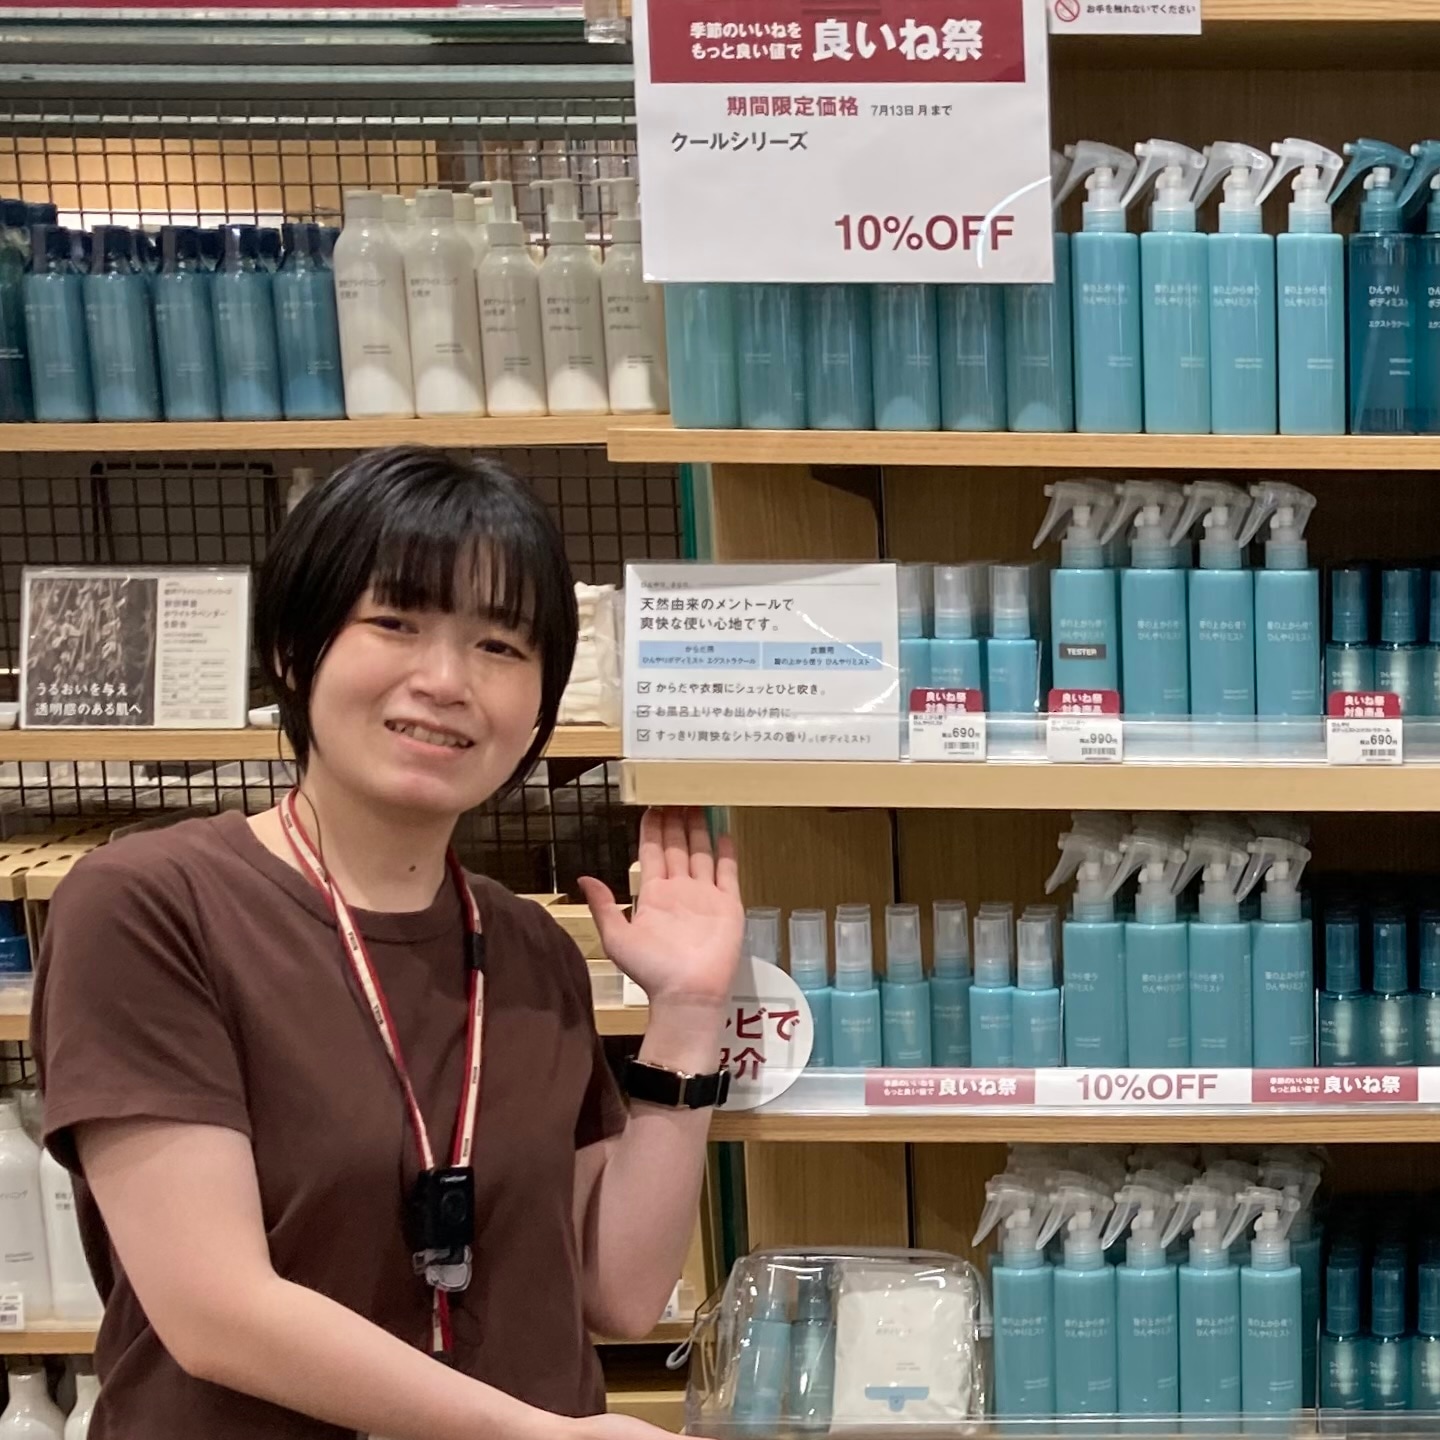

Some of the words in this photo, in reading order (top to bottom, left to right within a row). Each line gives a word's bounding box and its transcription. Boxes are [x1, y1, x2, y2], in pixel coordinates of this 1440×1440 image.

[1087, 4, 1195, 14] お手を触れないでください
[690, 22, 801, 39] 季節のいいねを
[813, 19, 982, 61] 良いね祭
[691, 42, 802, 60] もっと良い値で
[727, 96, 859, 117] 期間限定価格
[670, 132, 808, 152] クールシリーズ
[834, 214, 1014, 251] 10%OFF
[640, 597, 794, 611] 天然由来のメントールで
[640, 616, 778, 631] 爽快な使い心地です。
[36, 682, 128, 696] うるおいを与え
[656, 682, 826, 695] からだや衣類にシュッとひと吹き。
[34, 703, 143, 717] 透明感のある肌へ
[726, 1007, 800, 1041] ビで
[938, 1078, 1017, 1097] 良いね祭
[1076, 1074, 1218, 1101] 10%OFF
[1323, 1075, 1401, 1095] 良いね祭
